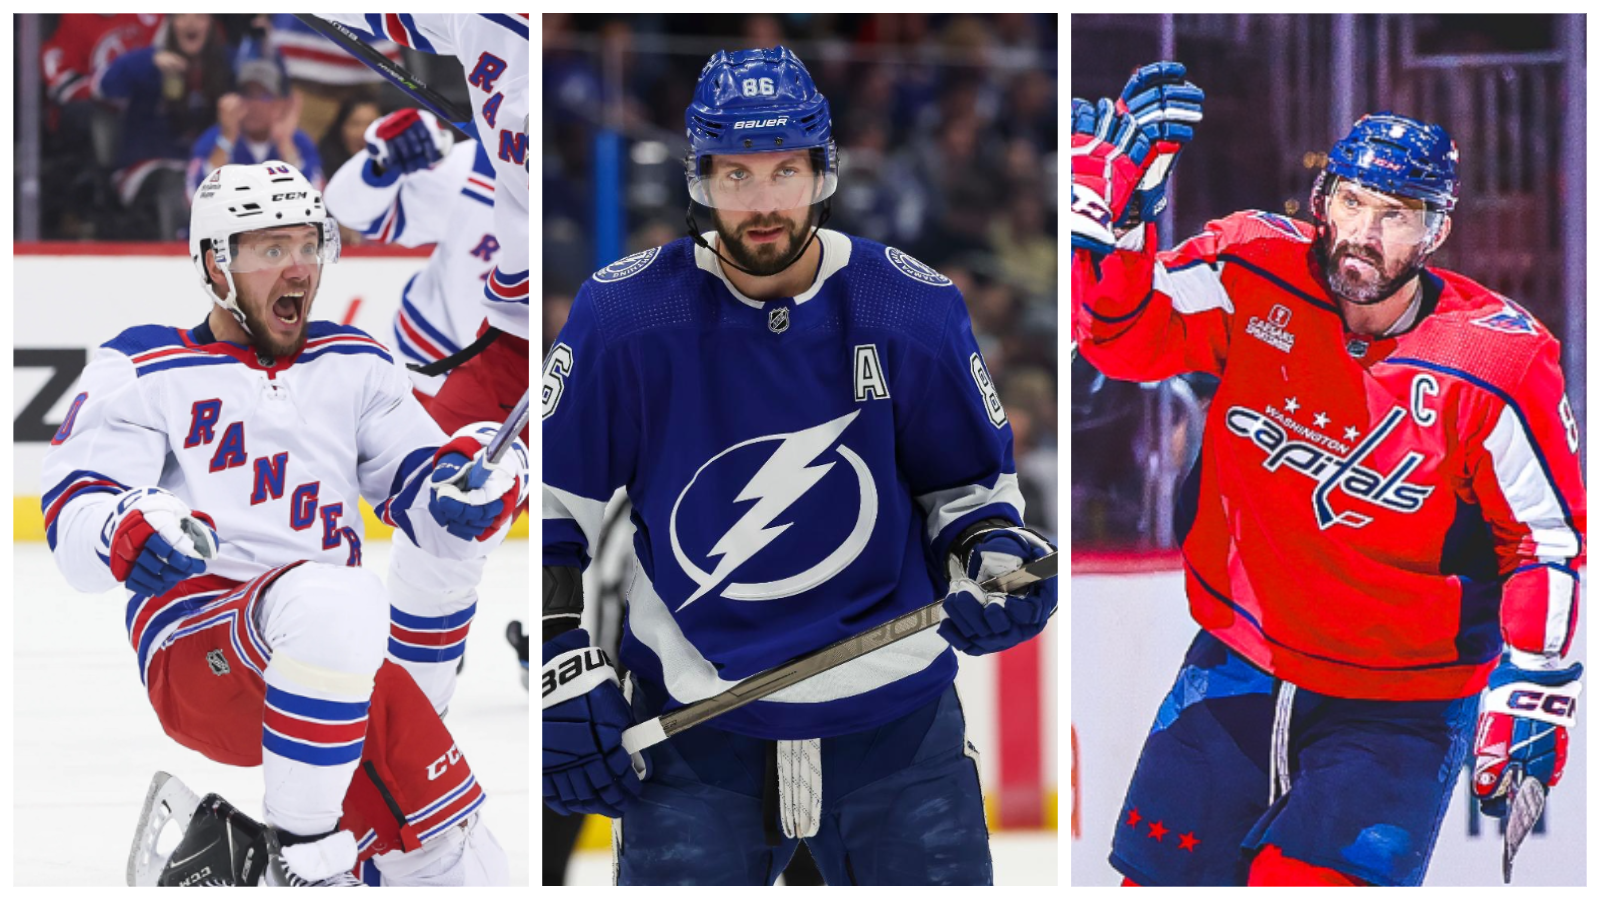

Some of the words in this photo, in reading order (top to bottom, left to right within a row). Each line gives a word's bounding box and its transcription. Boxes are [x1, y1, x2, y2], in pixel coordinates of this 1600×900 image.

[742, 77, 775, 97] 86
[271, 191, 308, 202] CCM
[854, 343, 891, 402] A
[1410, 373, 1439, 426] C
[1265, 404, 1350, 453] WASHINGTON
[425, 744, 463, 781] CC
